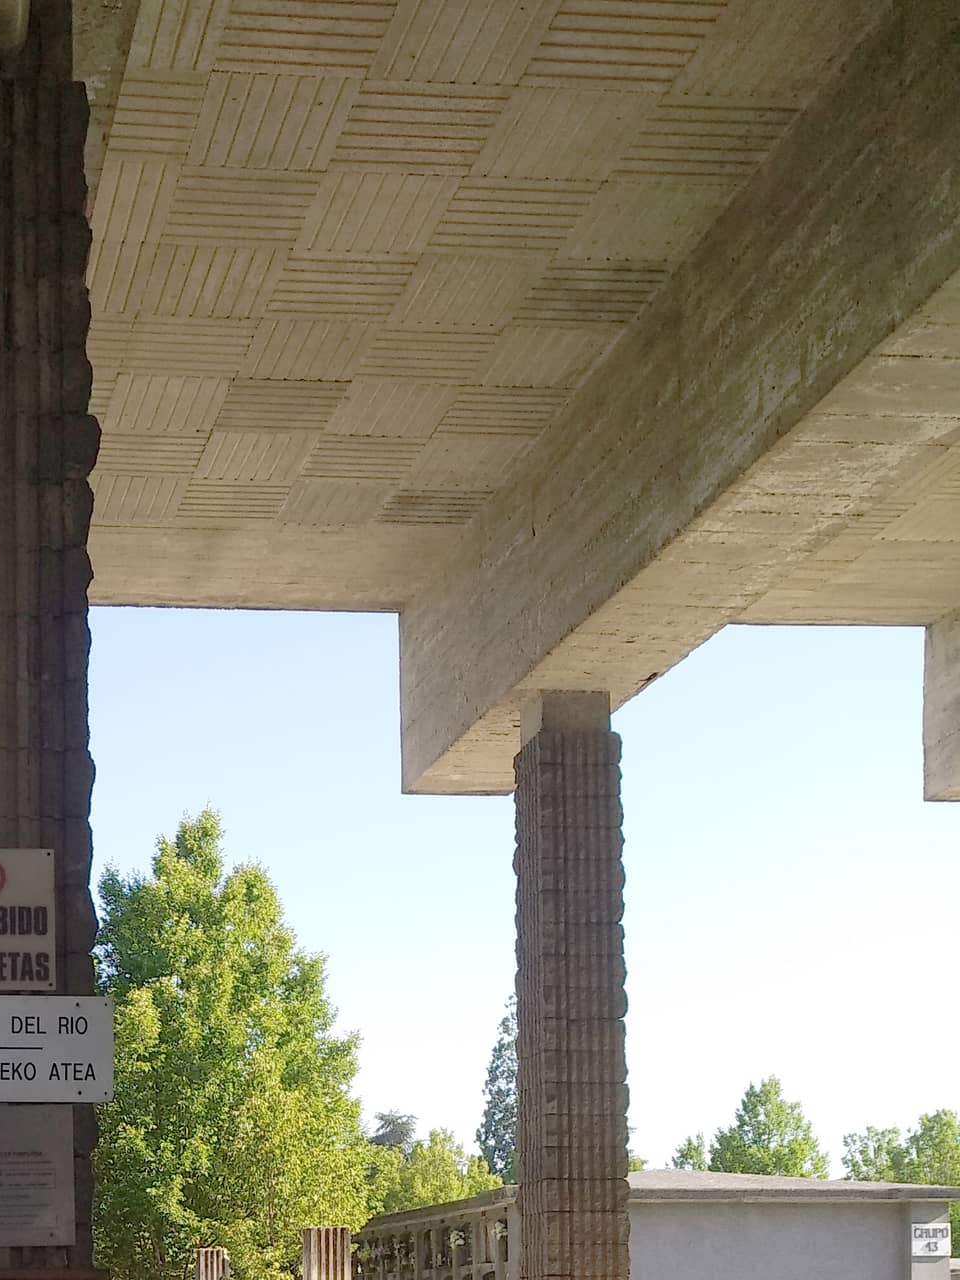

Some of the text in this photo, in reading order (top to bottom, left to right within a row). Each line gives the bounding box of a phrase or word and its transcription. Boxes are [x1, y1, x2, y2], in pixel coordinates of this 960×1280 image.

[11, 1016, 47, 1034] DEL
[58, 1016, 88, 1035] RIO
[48, 1063, 96, 1081] ATEA
